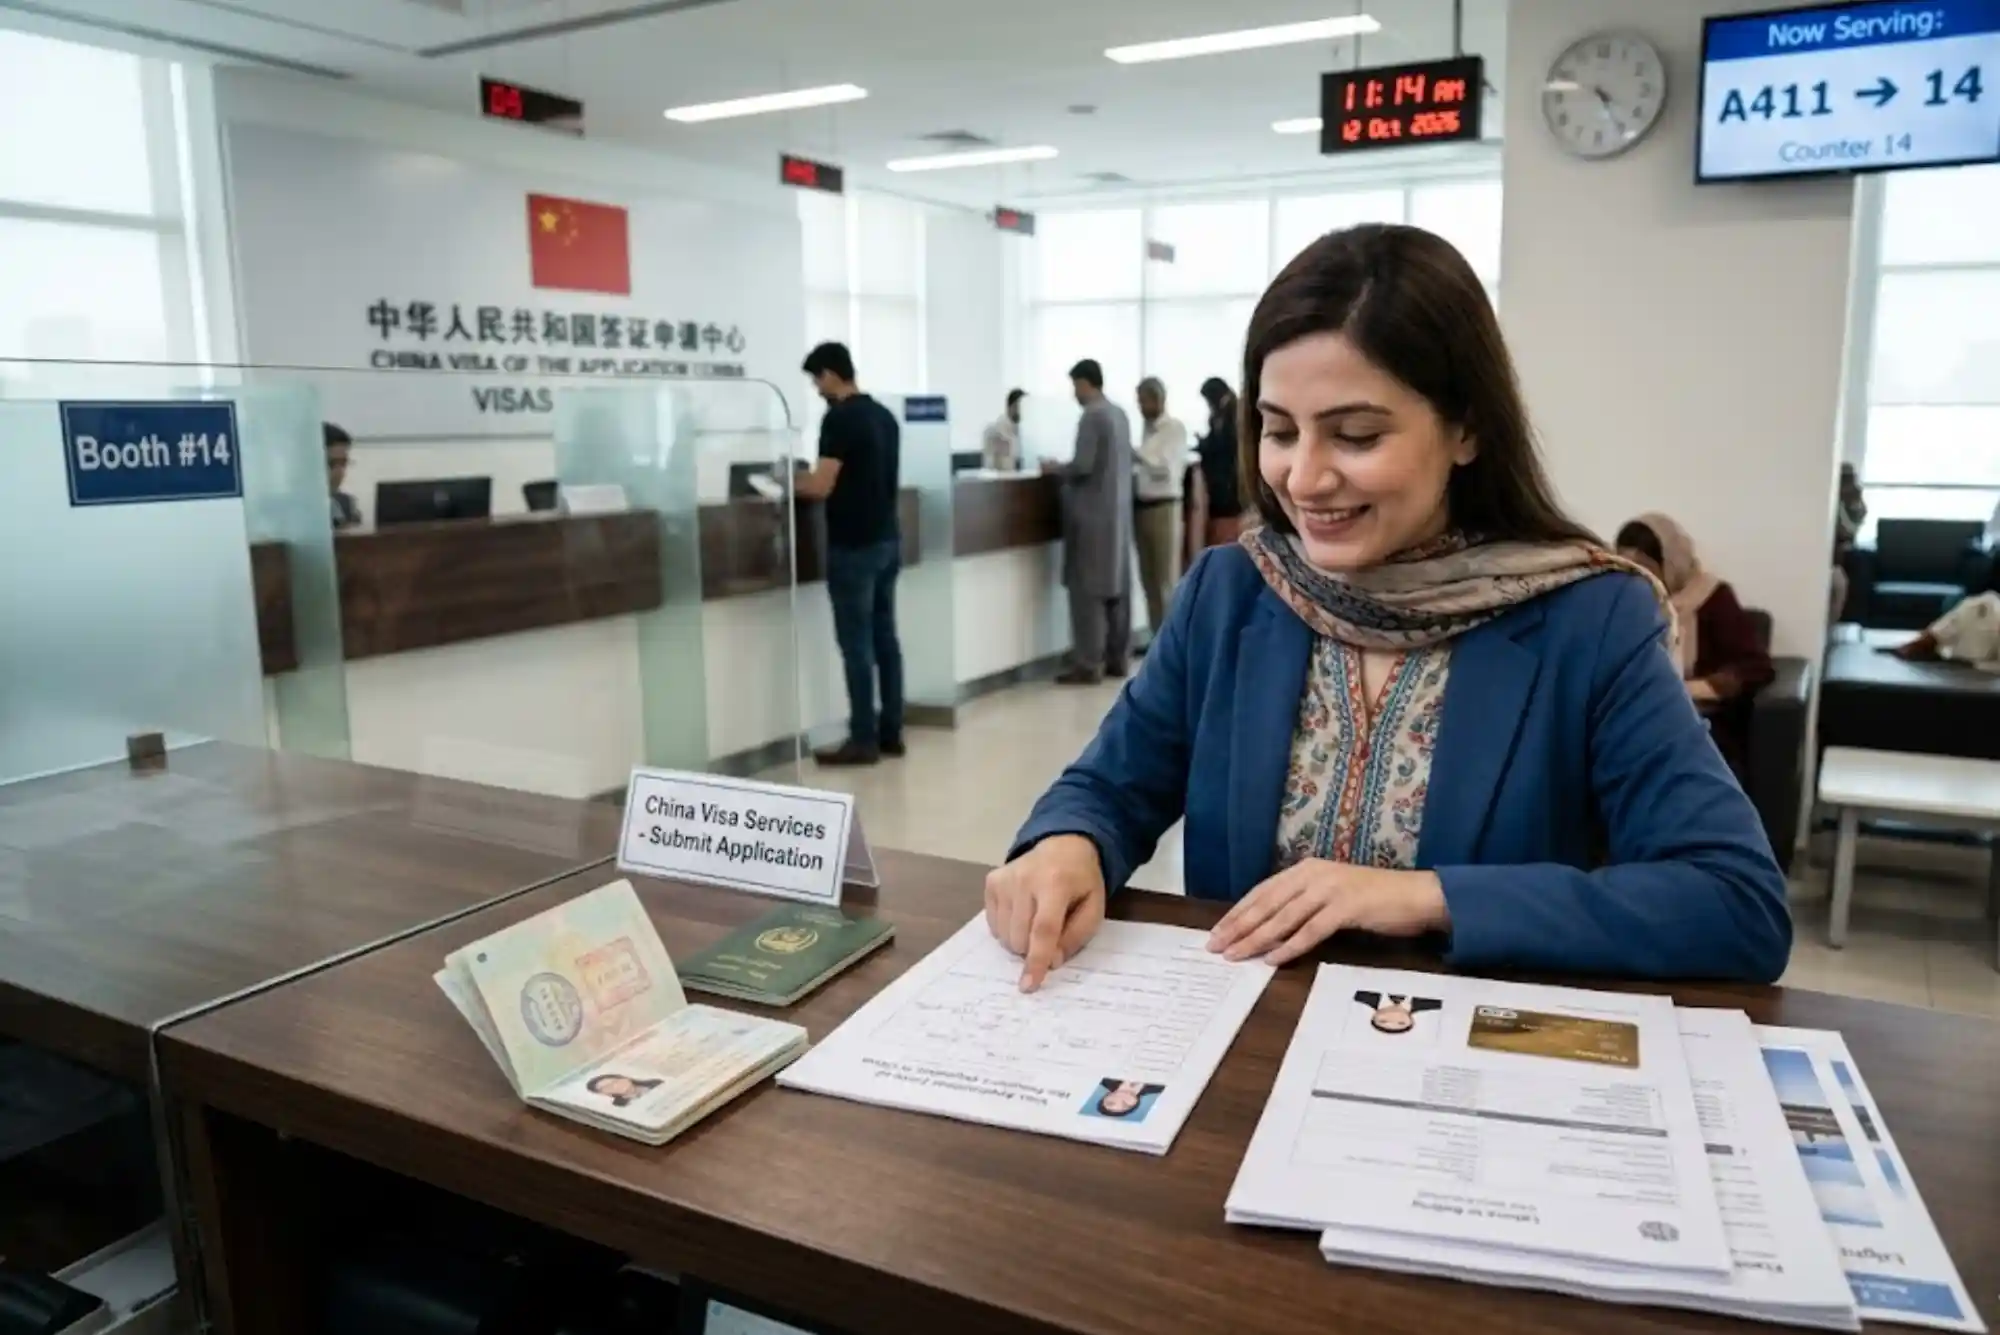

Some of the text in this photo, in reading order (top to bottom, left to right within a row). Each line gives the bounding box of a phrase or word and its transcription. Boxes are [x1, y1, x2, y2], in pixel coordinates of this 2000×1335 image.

[1768, 9, 1945, 47] Now Serving:
[1433, 78, 1466, 104] AM
[1718, 64, 1983, 124] A411 14
[1342, 118, 1361, 143] 12
[1368, 117, 1402, 140] Oct
[1778, 132, 1913, 163] Counter 14
[370, 349, 442, 371] CHINA
[448, 352, 498, 372] VISA
[472, 386, 554, 413] VISAS
[75, 432, 231, 471] Booth #14
[645, 794, 827, 841] China Visa Services
[649, 825, 713, 855] Submit
[716, 836, 823, 871] Application
